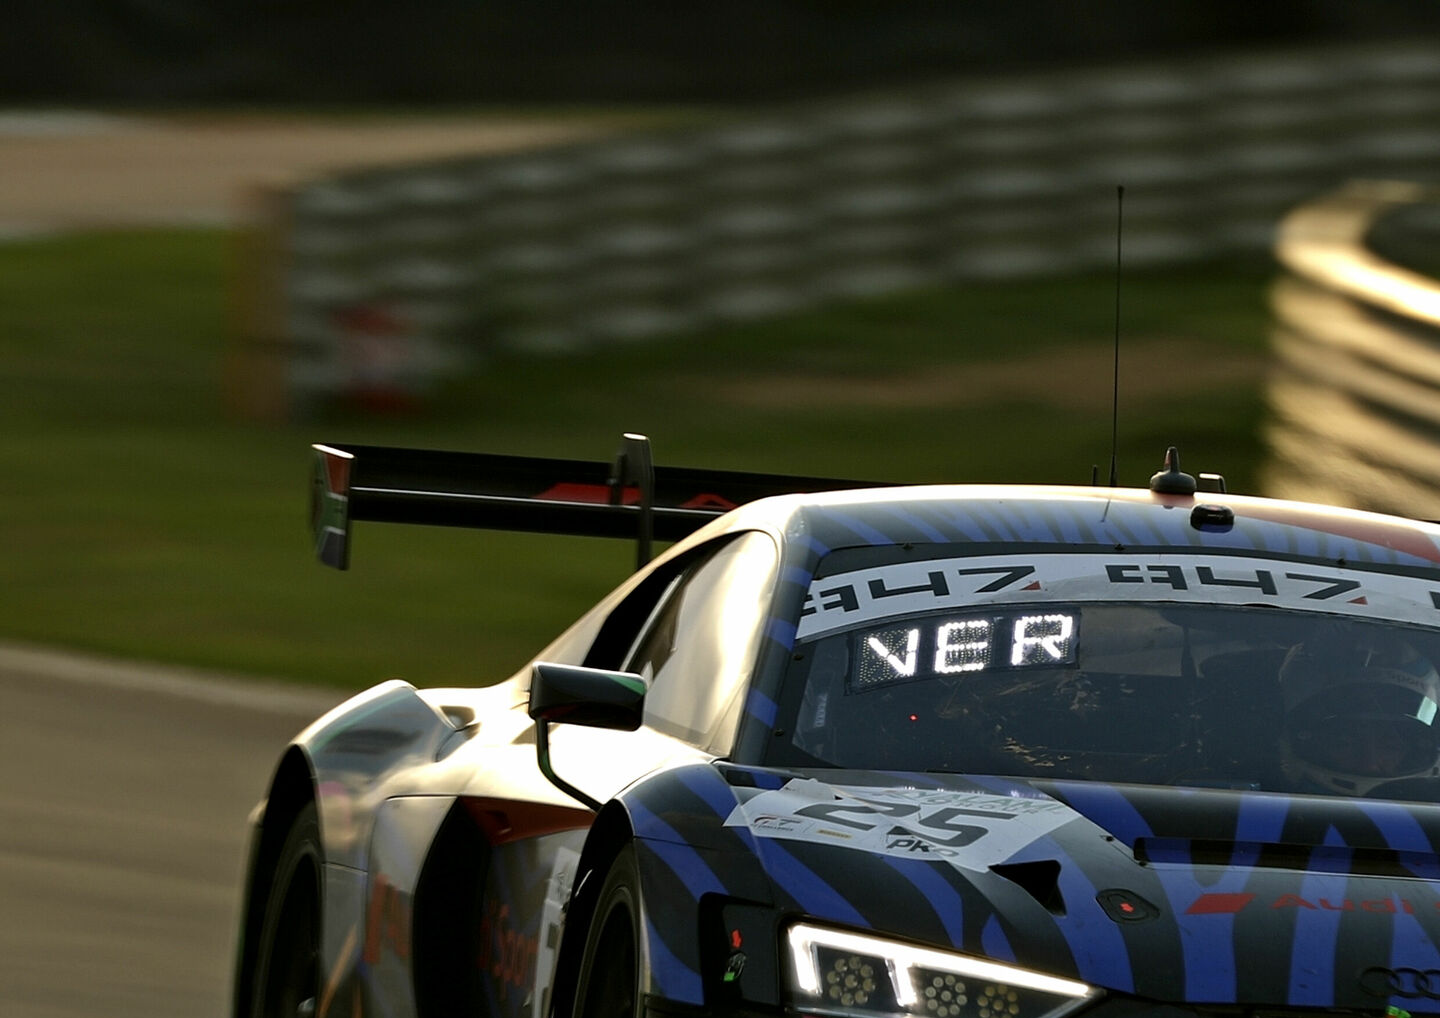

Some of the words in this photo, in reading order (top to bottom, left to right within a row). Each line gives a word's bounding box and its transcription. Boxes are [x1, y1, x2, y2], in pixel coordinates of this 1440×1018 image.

[1106, 564, 1361, 600] 947
[867, 613, 1074, 677] VER
[793, 797, 1019, 847] 25
[1269, 893, 1416, 915] Audi
